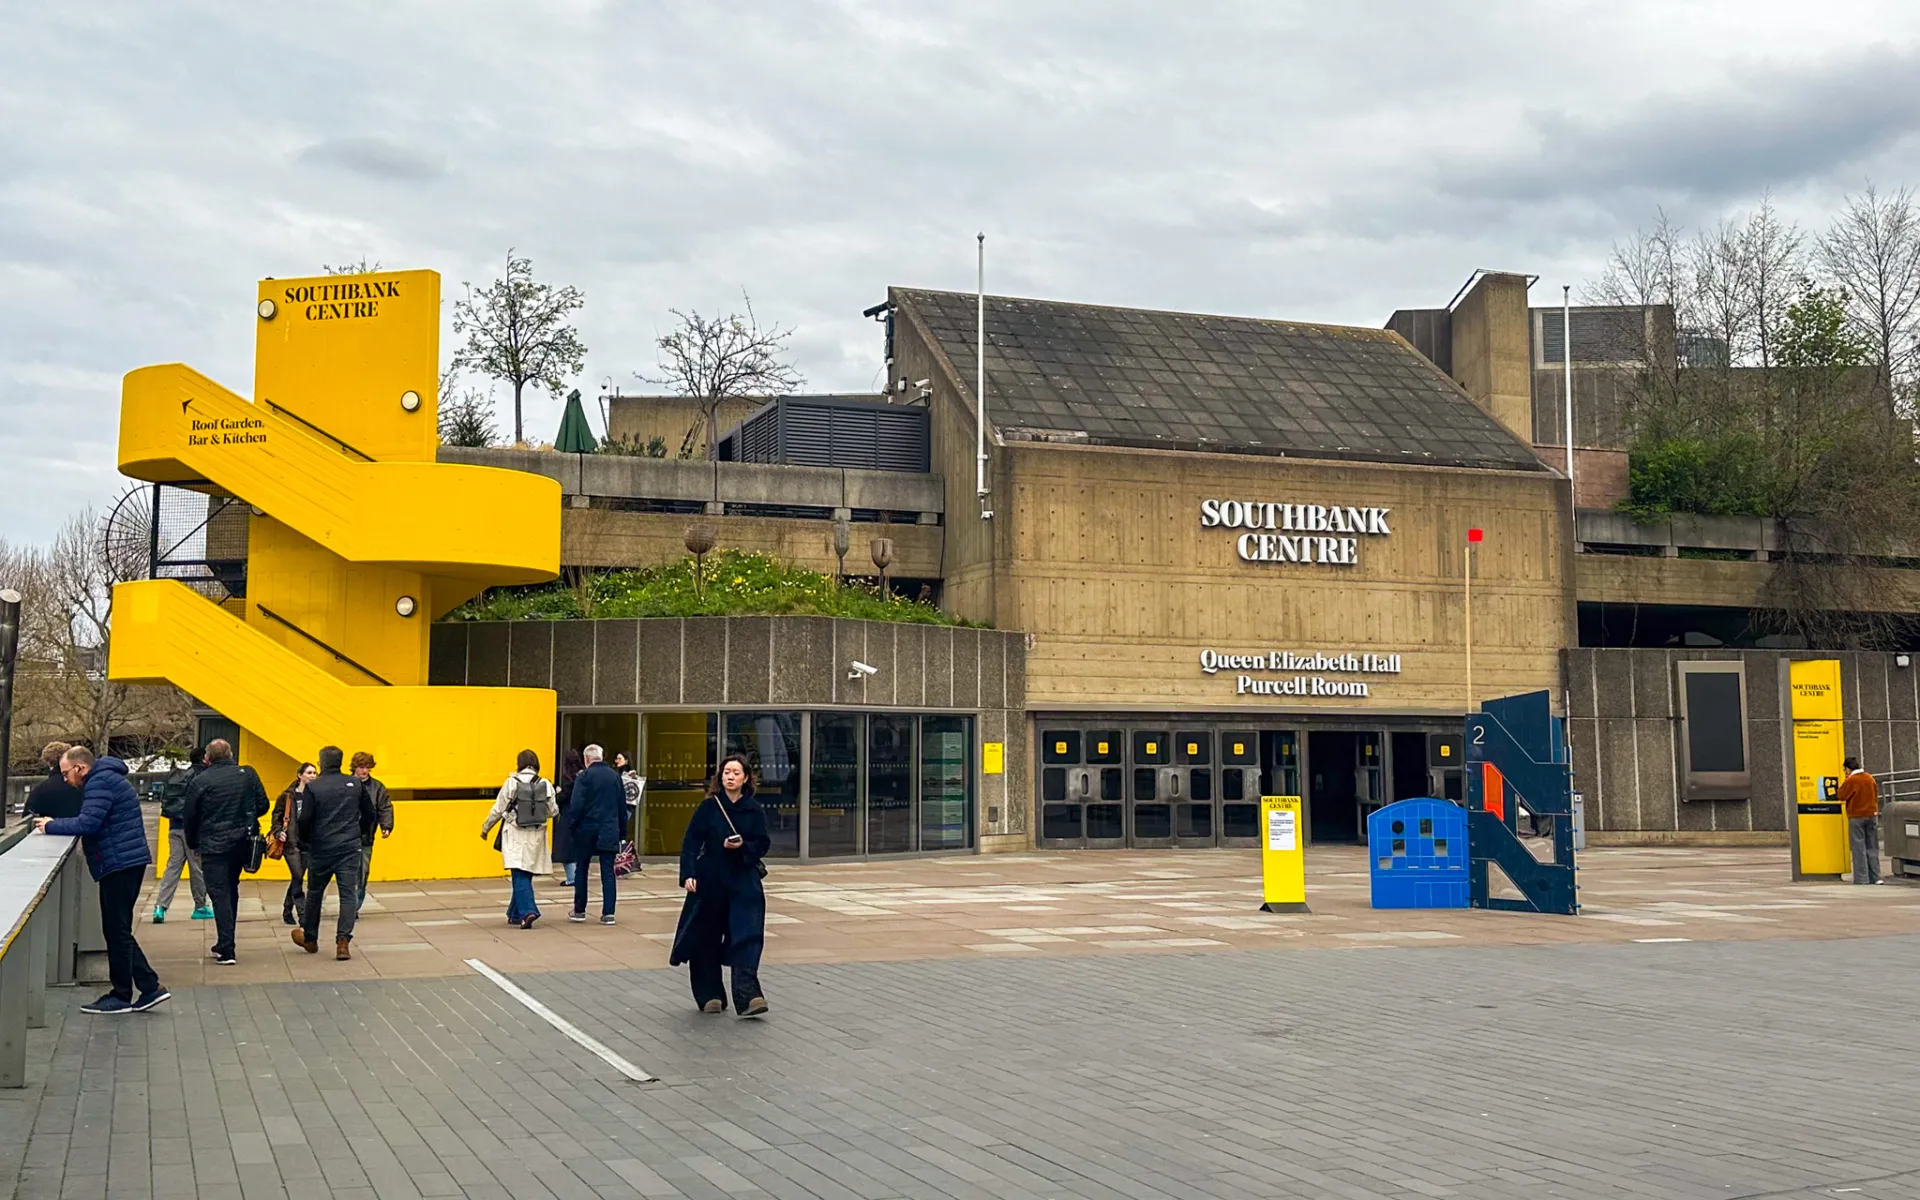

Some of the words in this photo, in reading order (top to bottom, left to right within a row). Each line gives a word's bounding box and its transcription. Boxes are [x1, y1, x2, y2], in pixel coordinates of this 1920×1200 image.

[285, 281, 400, 304] SOUTHBANK
[306, 301, 379, 321] CENTRE
[192, 419, 219, 431] Roof
[188, 434, 209, 446] Bar
[210, 433, 220, 445] &
[223, 432, 267, 445] Kitchen
[1201, 499, 1391, 534] SOUTHBANK
[1237, 533, 1358, 565] CENTRE
[1200, 649, 1265, 673] Queen
[1268, 651, 1359, 672] Elizabeth
[1362, 653, 1401, 673] Hall
[1237, 675, 1307, 695] Purcell
[1311, 677, 1368, 696] Room
[1472, 725, 1485, 745] 2
